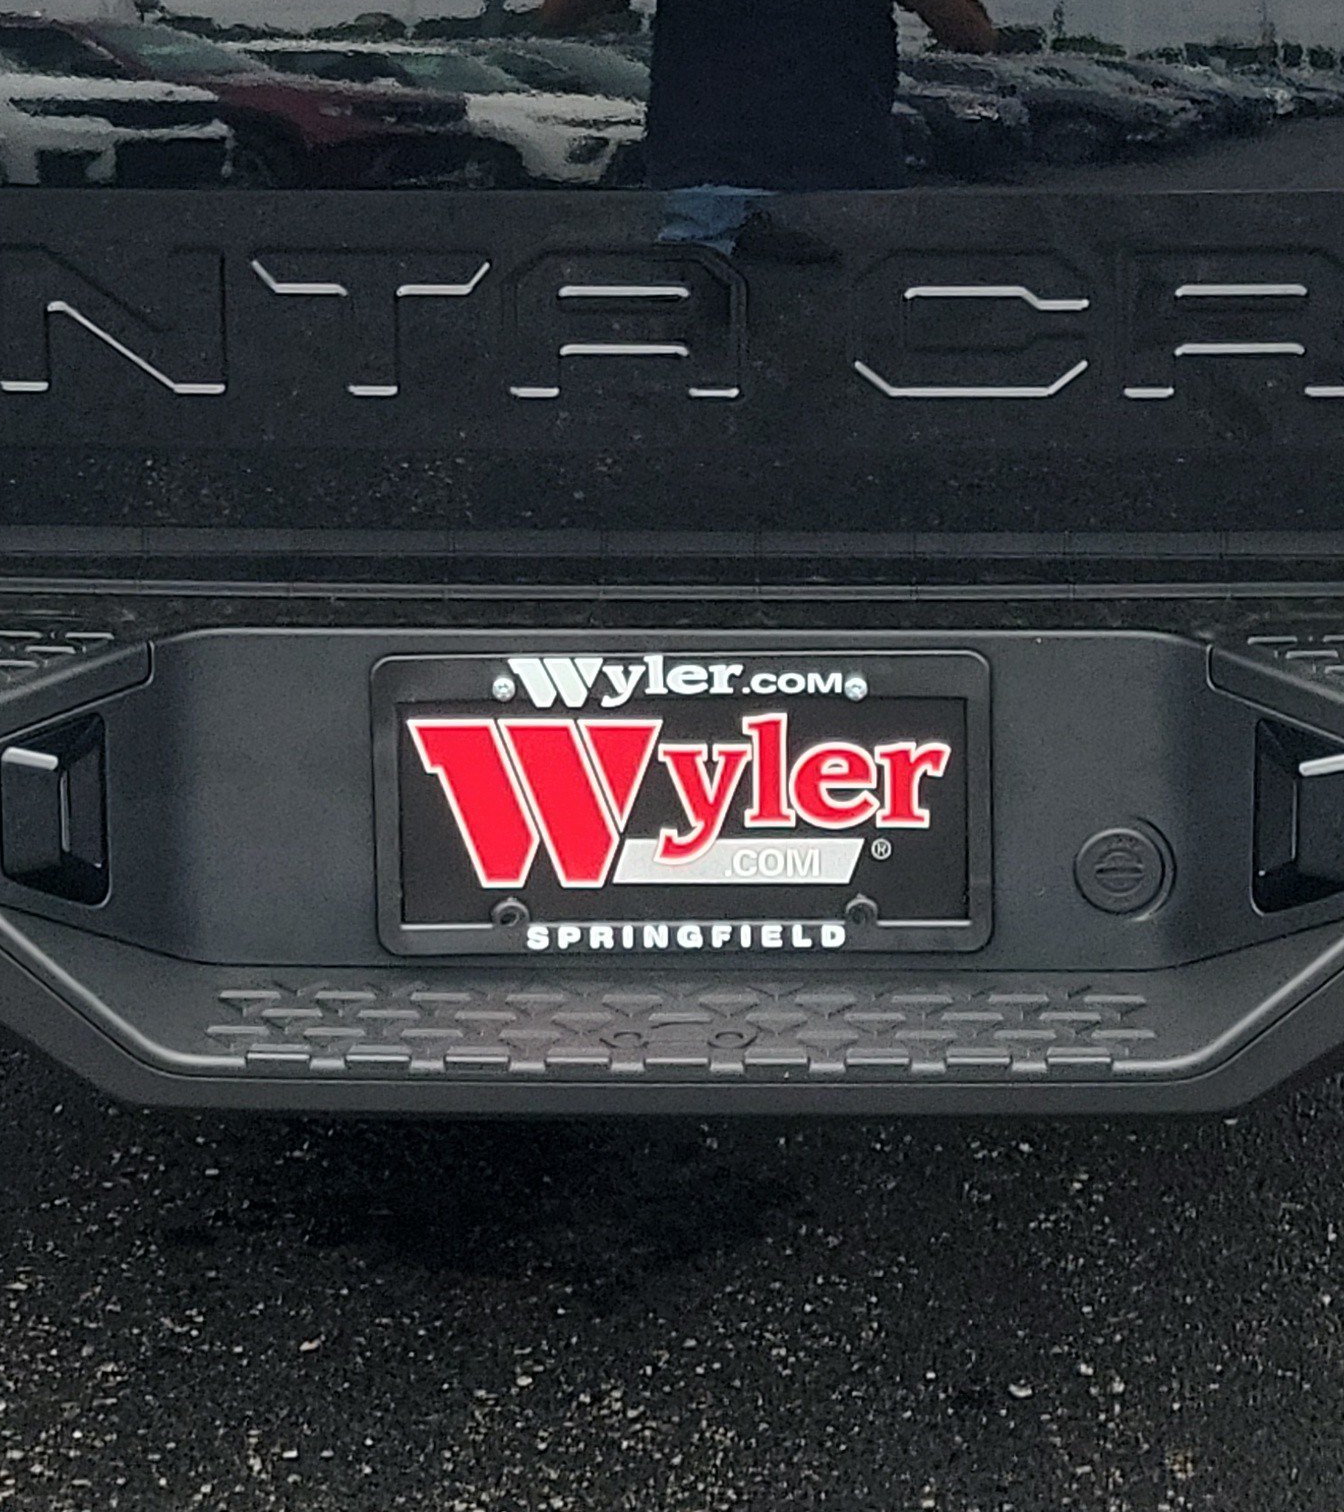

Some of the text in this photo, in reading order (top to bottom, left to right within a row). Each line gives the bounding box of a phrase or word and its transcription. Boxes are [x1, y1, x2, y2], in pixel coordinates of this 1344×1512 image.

[406, 711, 952, 889] Wyler
[723, 849, 822, 878] .COM
[526, 924, 847, 950] SPRINGFIELD
